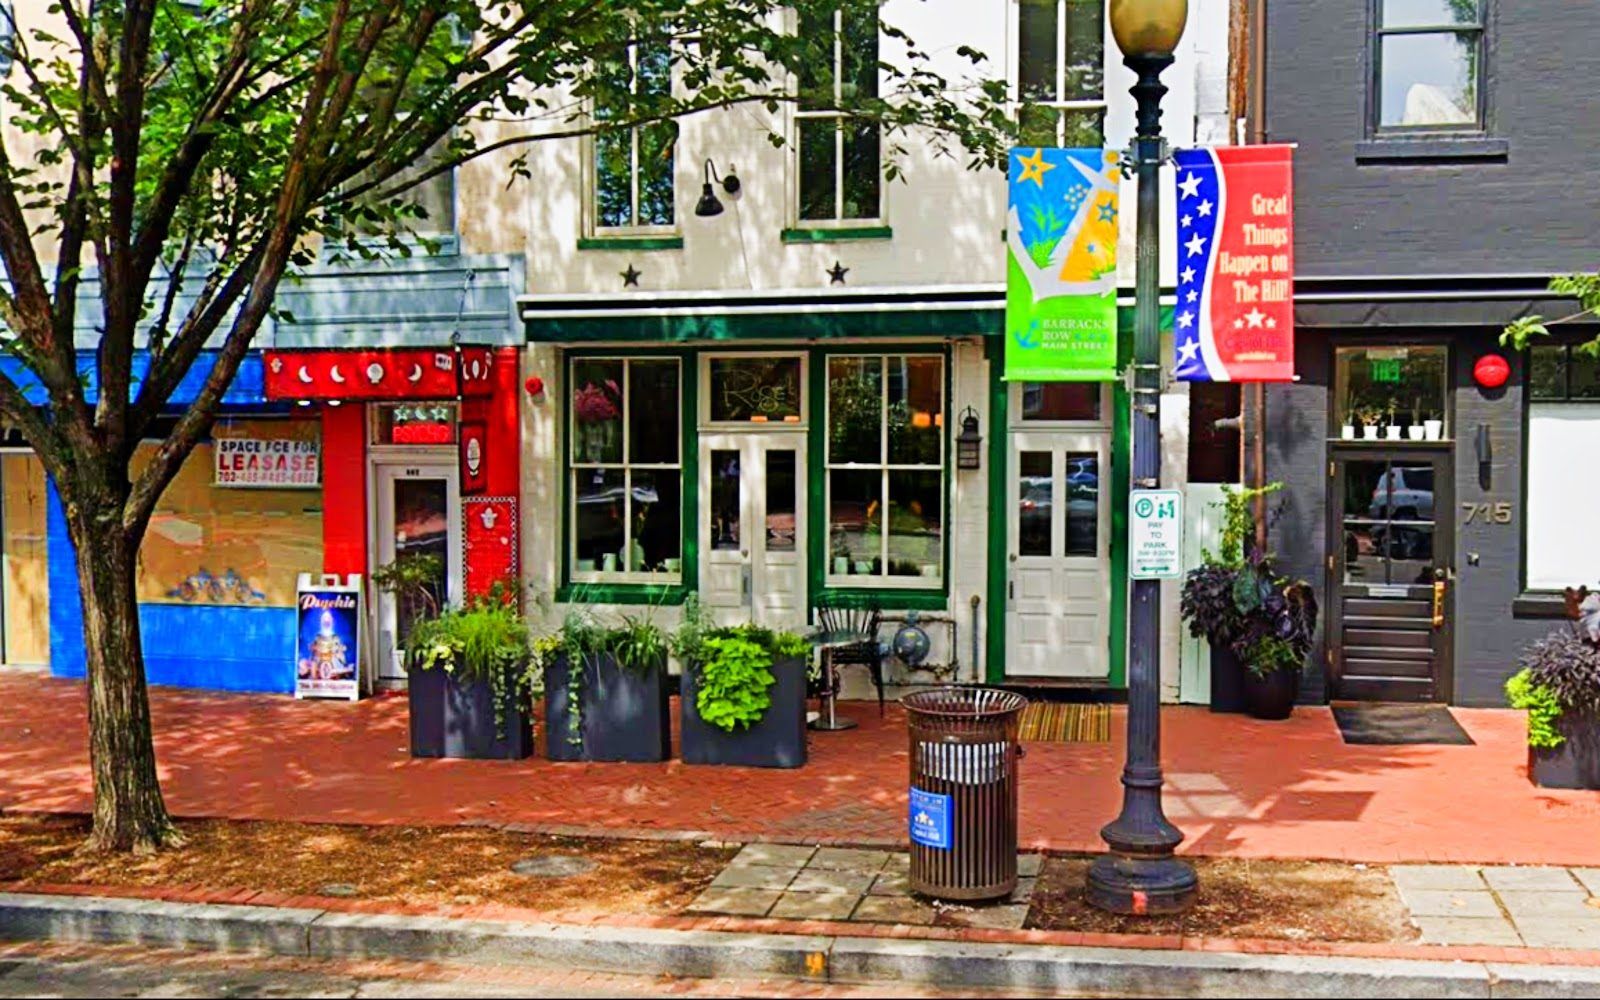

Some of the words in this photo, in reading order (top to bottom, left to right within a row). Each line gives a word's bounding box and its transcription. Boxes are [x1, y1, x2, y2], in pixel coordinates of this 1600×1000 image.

[1252, 193, 1287, 216] Great
[1243, 223, 1288, 248] Things
[1220, 251, 1268, 276] Happen
[1271, 254, 1288, 273] on
[1233, 280, 1259, 303] The
[1261, 279, 1289, 303] Hill!
[1042, 319, 1108, 330] BARRACKS
[1042, 331, 1073, 341] ROW
[1041, 341, 1068, 350] MAIN
[220, 440, 260, 453] SPACE
[293, 441, 318, 453] FOR
[219, 453, 316, 471] LEASASE
[1462, 501, 1513, 525] 715
[1147, 521, 1163, 529] PAY
[1150, 531, 1162, 539] TO
[1143, 541, 1167, 549] PARK
